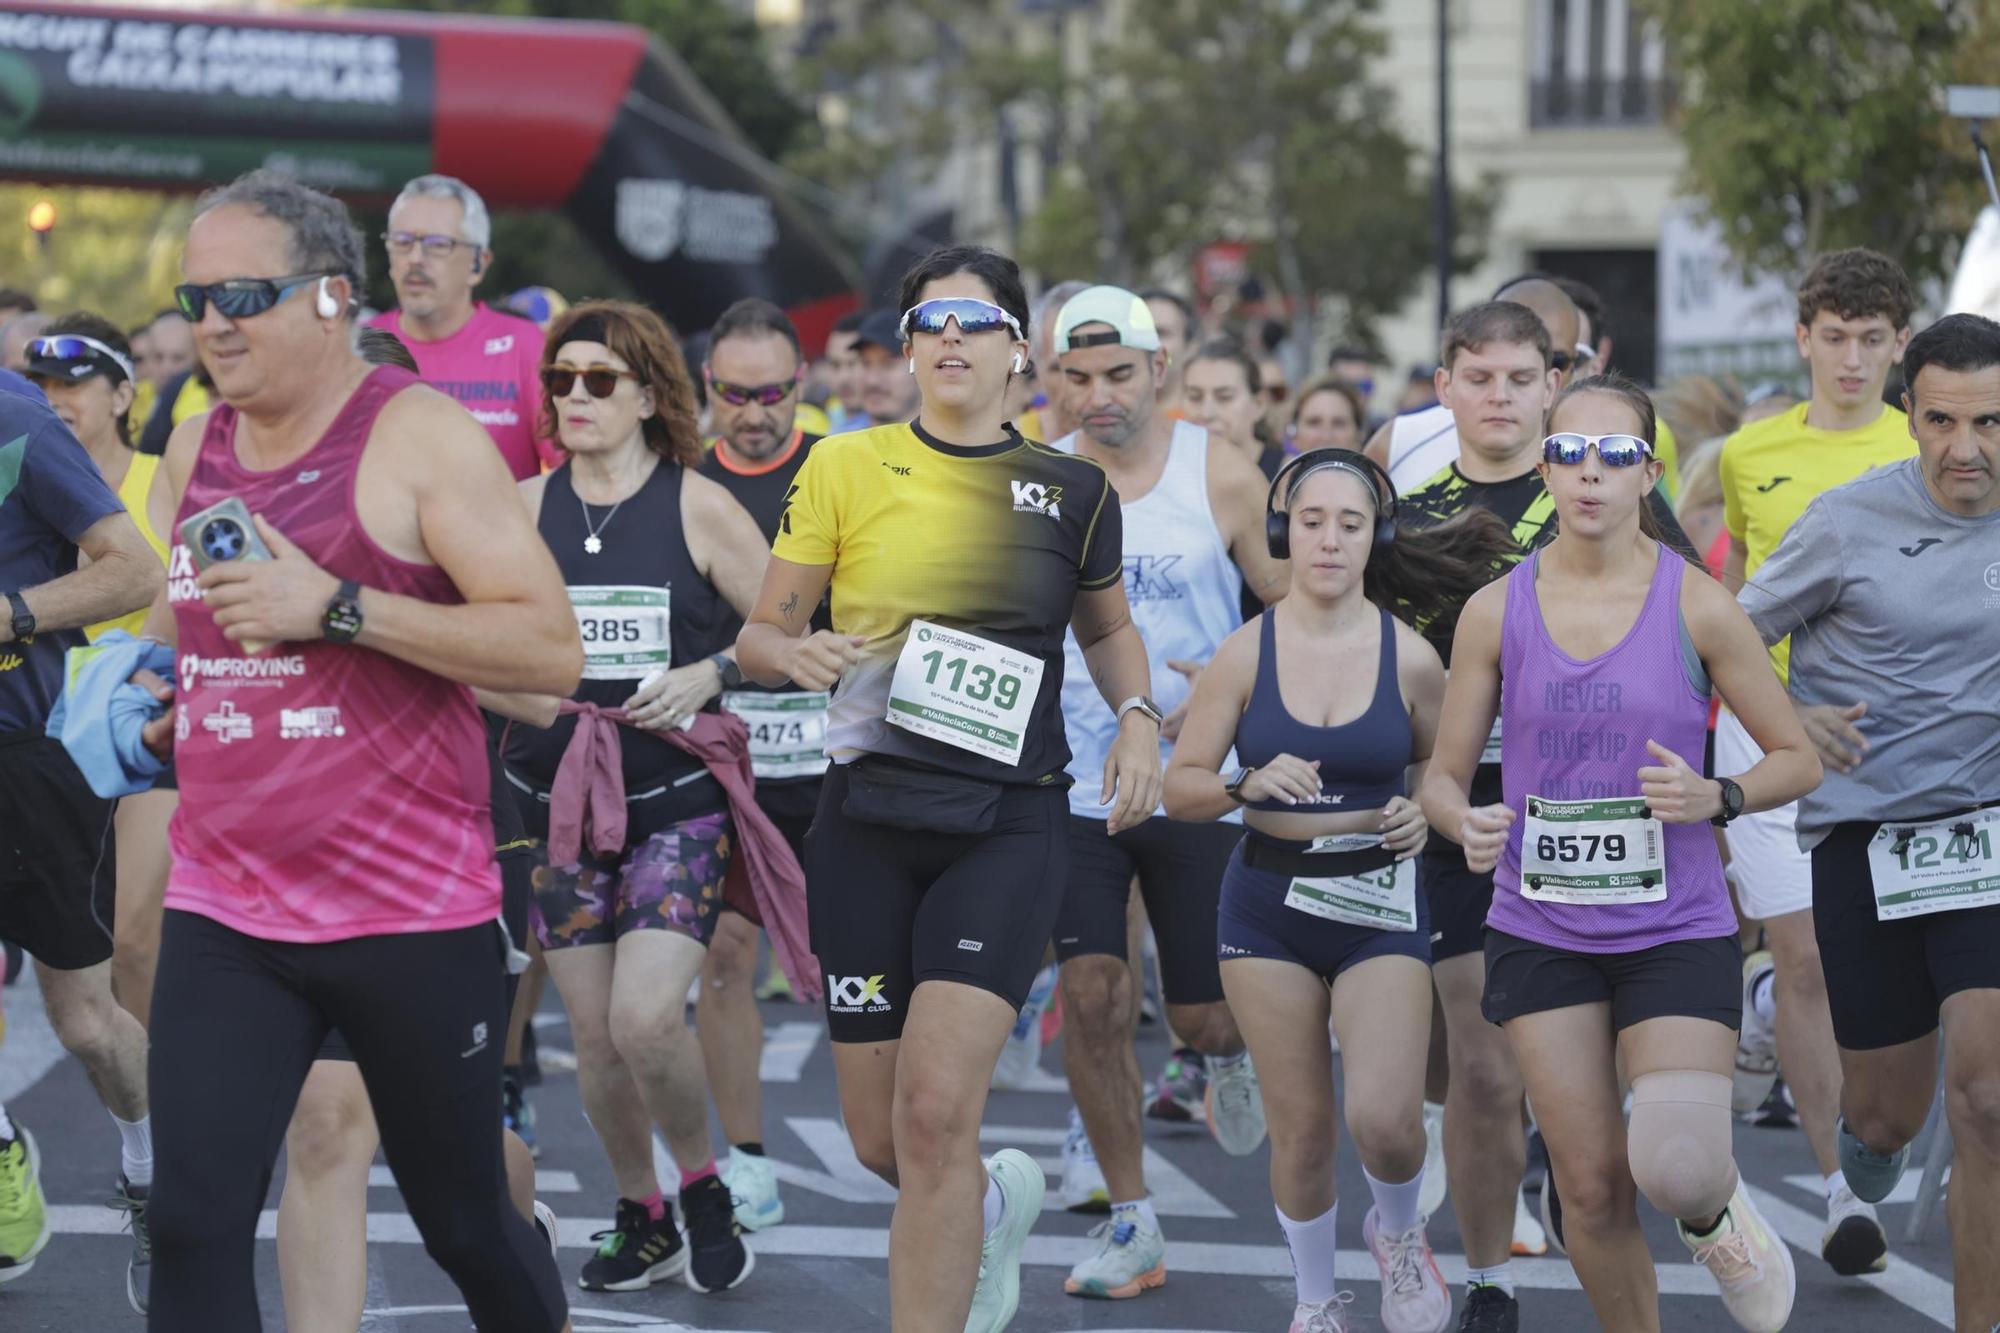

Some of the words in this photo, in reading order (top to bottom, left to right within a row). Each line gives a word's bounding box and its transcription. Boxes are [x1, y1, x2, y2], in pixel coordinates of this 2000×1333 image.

[175, 24, 399, 64] CARRERES
[582, 619, 640, 642] 385
[200, 655, 306, 677] IMPROVING
[922, 649, 1022, 711] 1139
[1544, 682, 1622, 713] NEVER
[921, 708, 983, 735] #ValènciaCorre
[1538, 728, 1591, 761] GIVE
[1600, 731, 1628, 762] UP
[1537, 834, 1627, 862] 6579
[1889, 829, 1992, 871] 1241
[1541, 876, 1600, 887] #ValènciaCorre
[867, 1004, 892, 1012] CLUB
